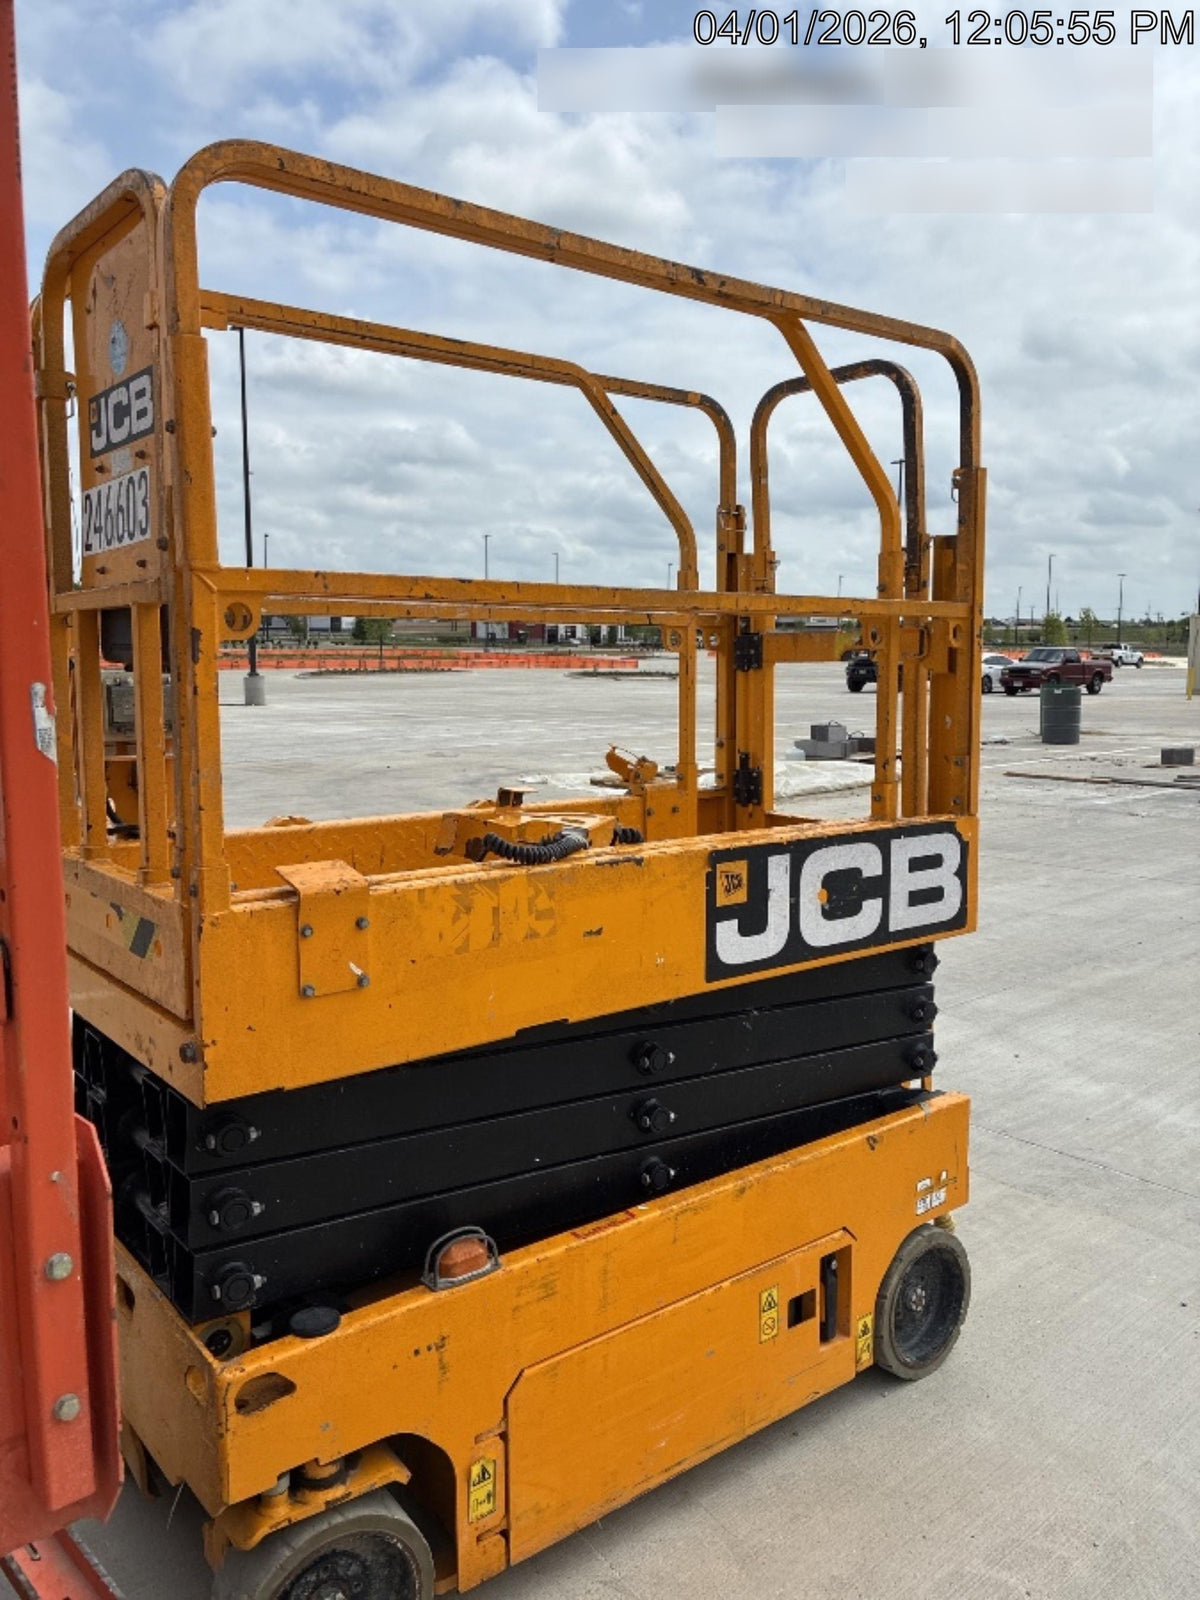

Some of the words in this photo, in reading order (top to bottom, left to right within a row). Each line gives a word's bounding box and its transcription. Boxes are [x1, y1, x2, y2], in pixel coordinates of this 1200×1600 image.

[91, 374, 153, 451] JCB
[84, 470, 149, 551] 246603
[716, 832, 962, 965] JCB
